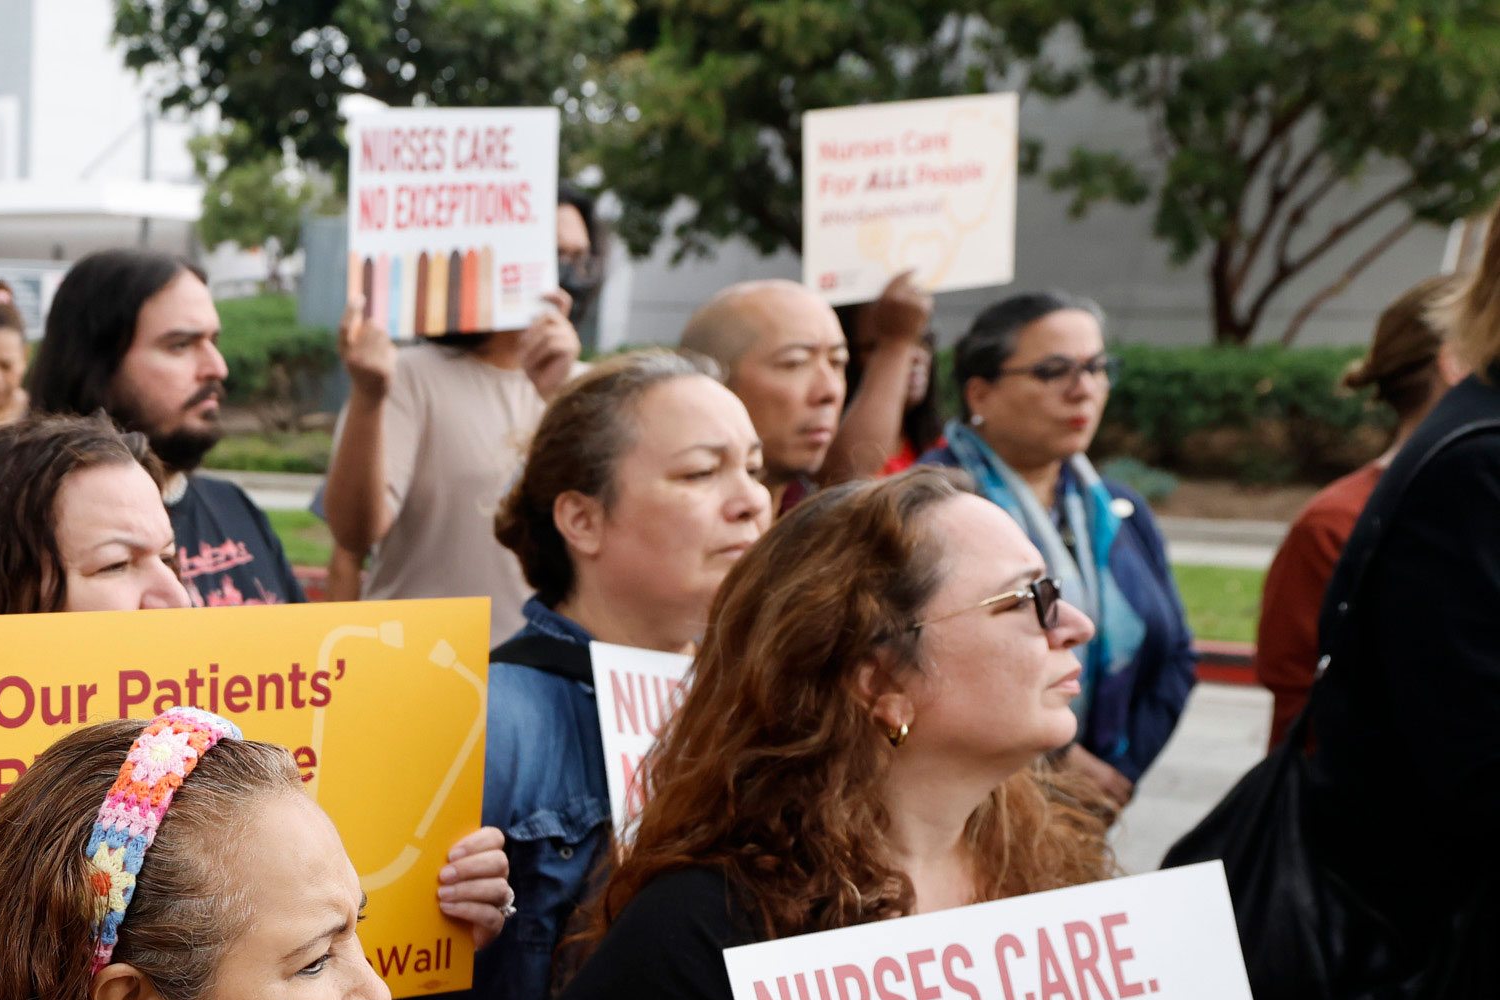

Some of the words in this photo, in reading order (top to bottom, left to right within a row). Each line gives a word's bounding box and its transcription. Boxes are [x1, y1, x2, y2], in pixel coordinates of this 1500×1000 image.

[360, 127, 446, 171] NURSES
[819, 138, 895, 161] Nurses
[819, 174, 856, 196] For
[865, 166, 908, 191] ALL
[916, 162, 985, 184] People
[359, 186, 388, 230] NO
